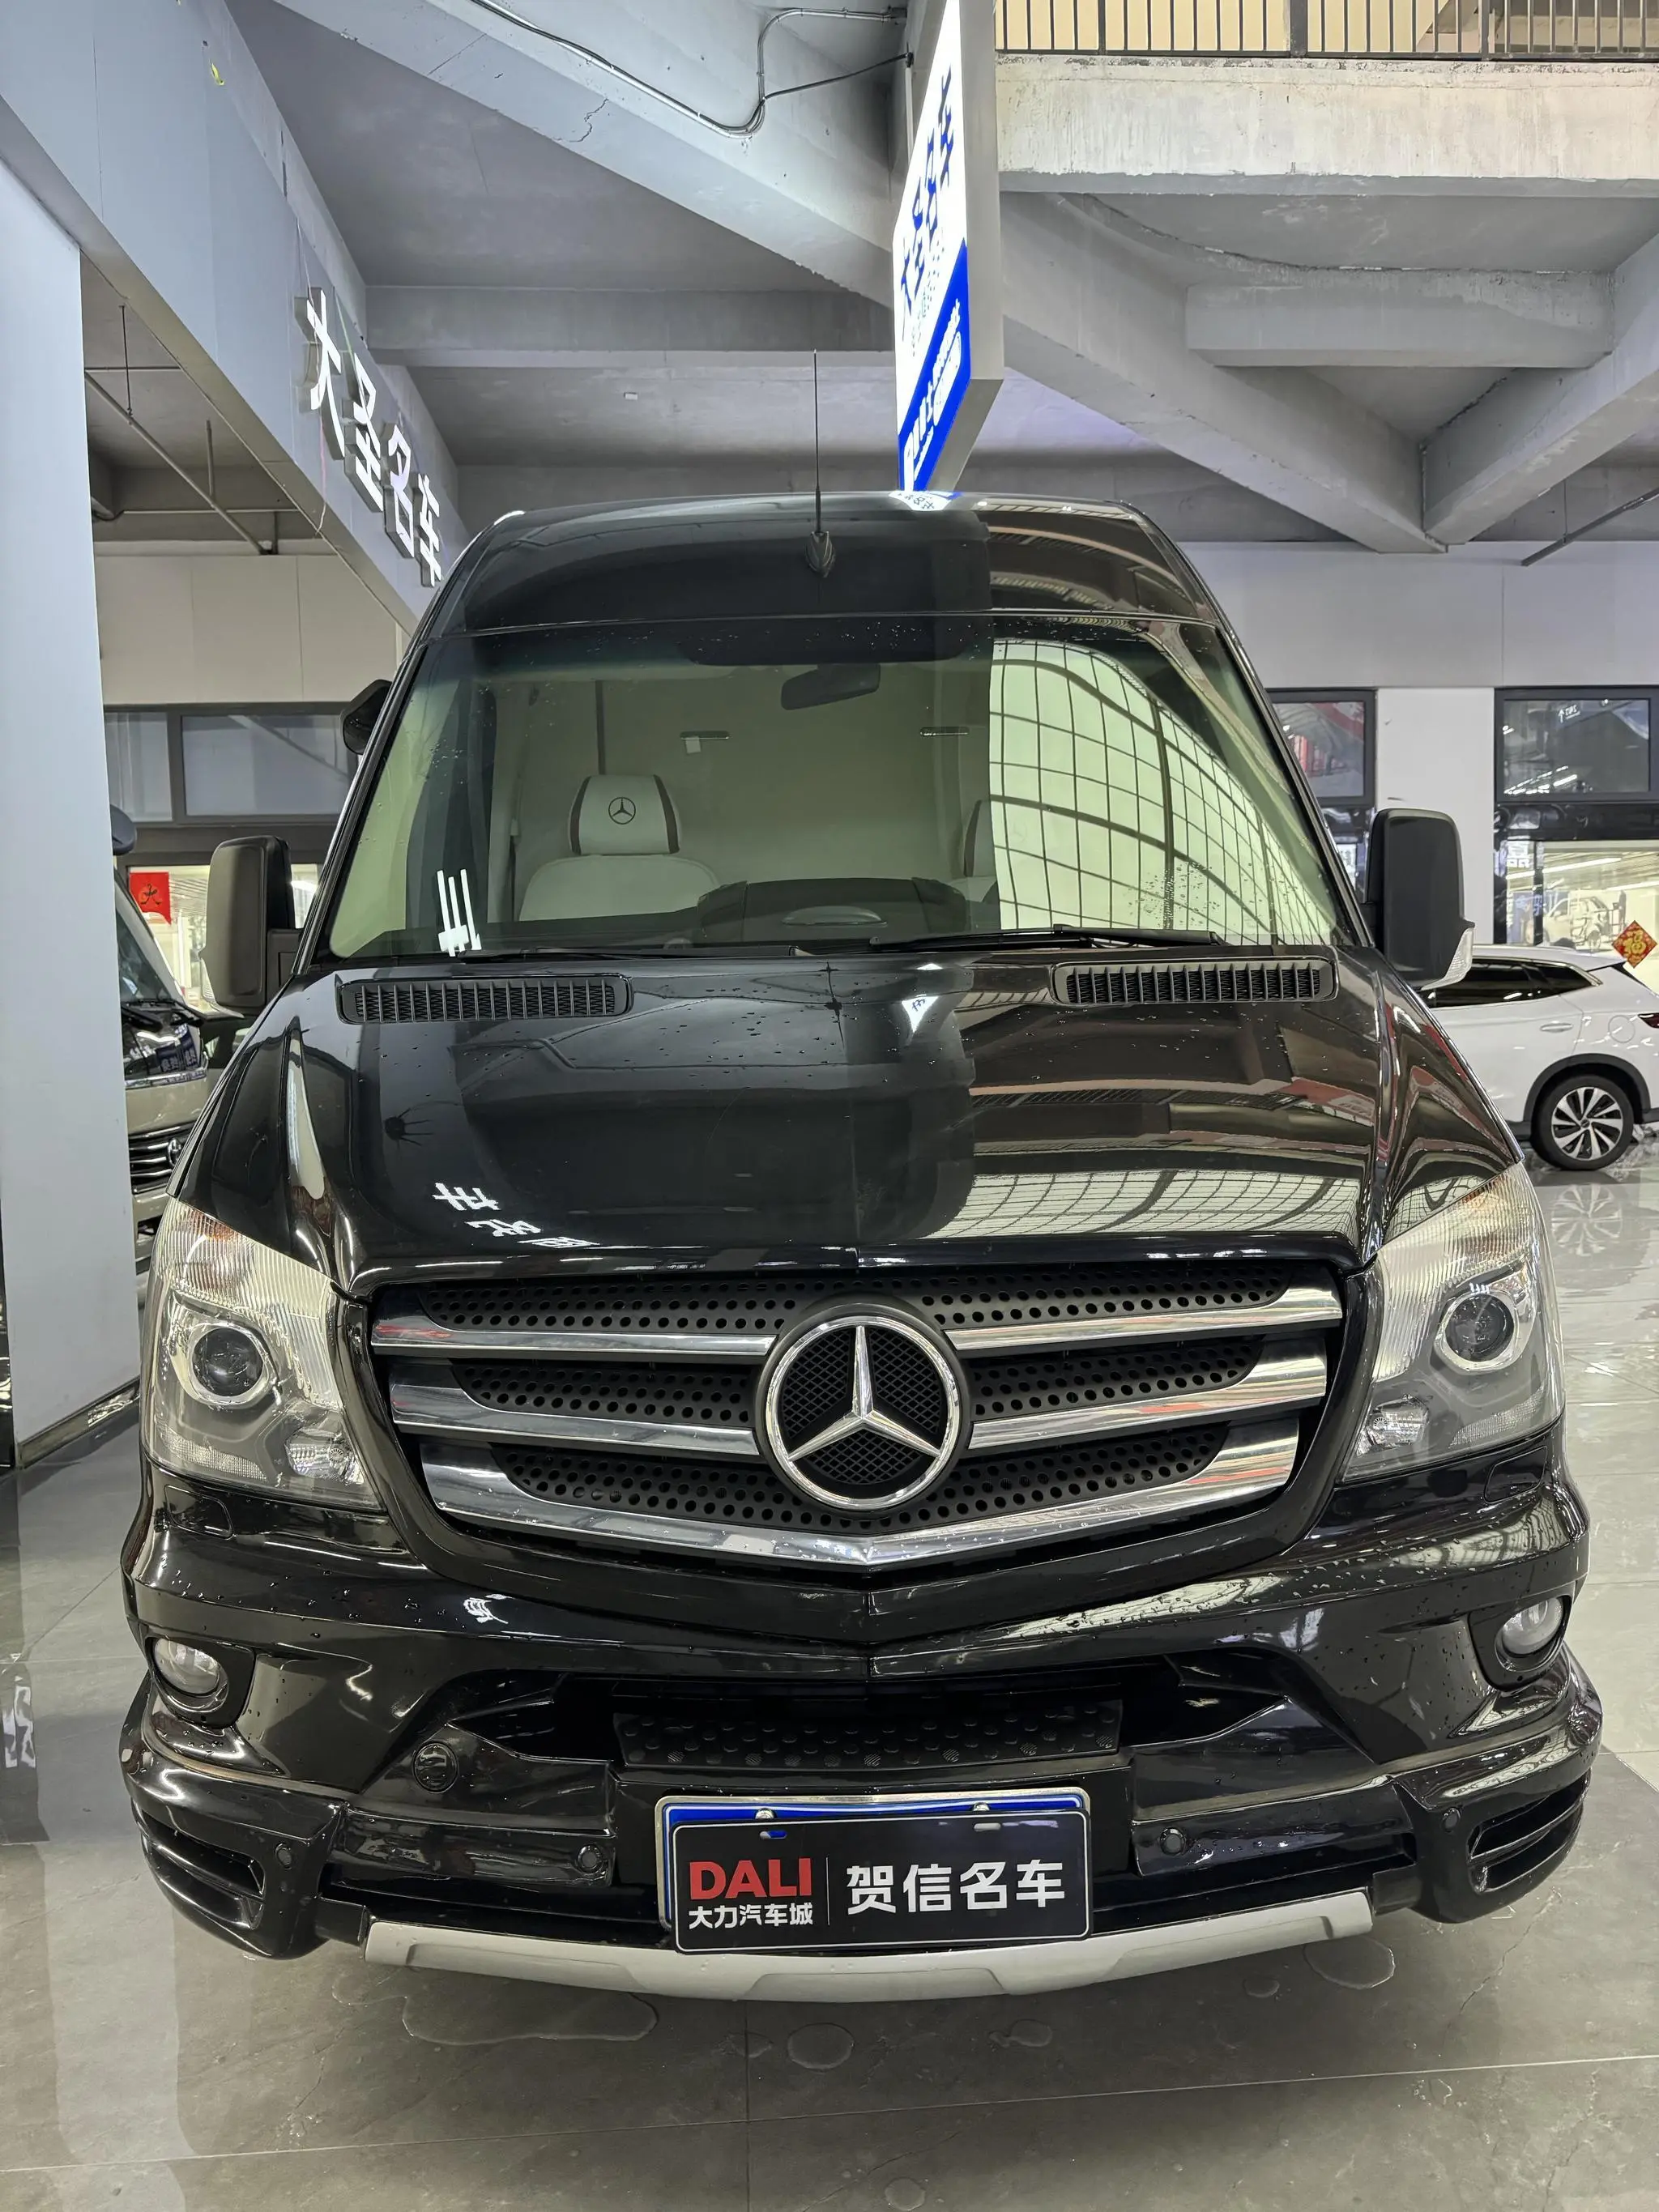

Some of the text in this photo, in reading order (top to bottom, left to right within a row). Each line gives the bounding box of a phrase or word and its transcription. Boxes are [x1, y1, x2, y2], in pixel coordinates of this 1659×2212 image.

[306, 289, 442, 587] 大圣名车
[689, 1857, 812, 1900] DALI
[846, 1858, 1066, 1916] 贺信名车
[689, 1902, 813, 1930] 大力汽车城
